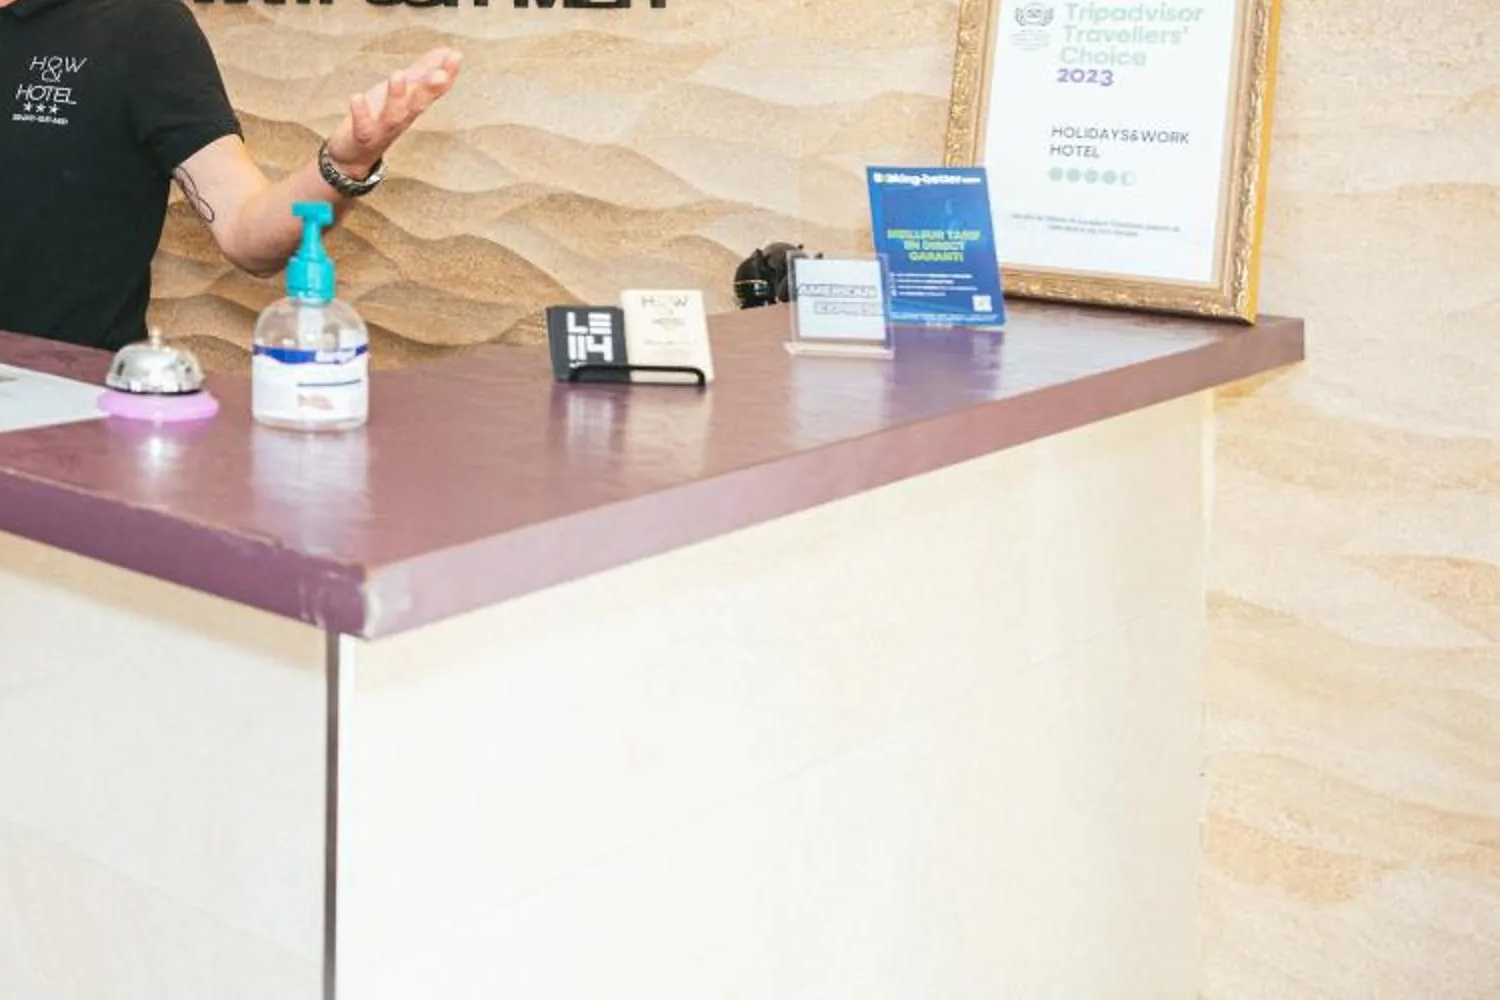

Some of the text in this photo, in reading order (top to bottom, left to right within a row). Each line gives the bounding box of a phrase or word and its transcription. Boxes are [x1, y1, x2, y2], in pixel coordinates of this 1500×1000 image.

[1064, 2, 1204, 25] Tripadvisor
[1063, 25, 1188, 44] Travellers'
[1059, 45, 1148, 66] Choice
[1057, 68, 1114, 86] 2023
[15, 84, 77, 105] HOTEL
[1051, 125, 1190, 145] HOLIDAYS&WORK
[1050, 144, 1100, 158] HOTEL
